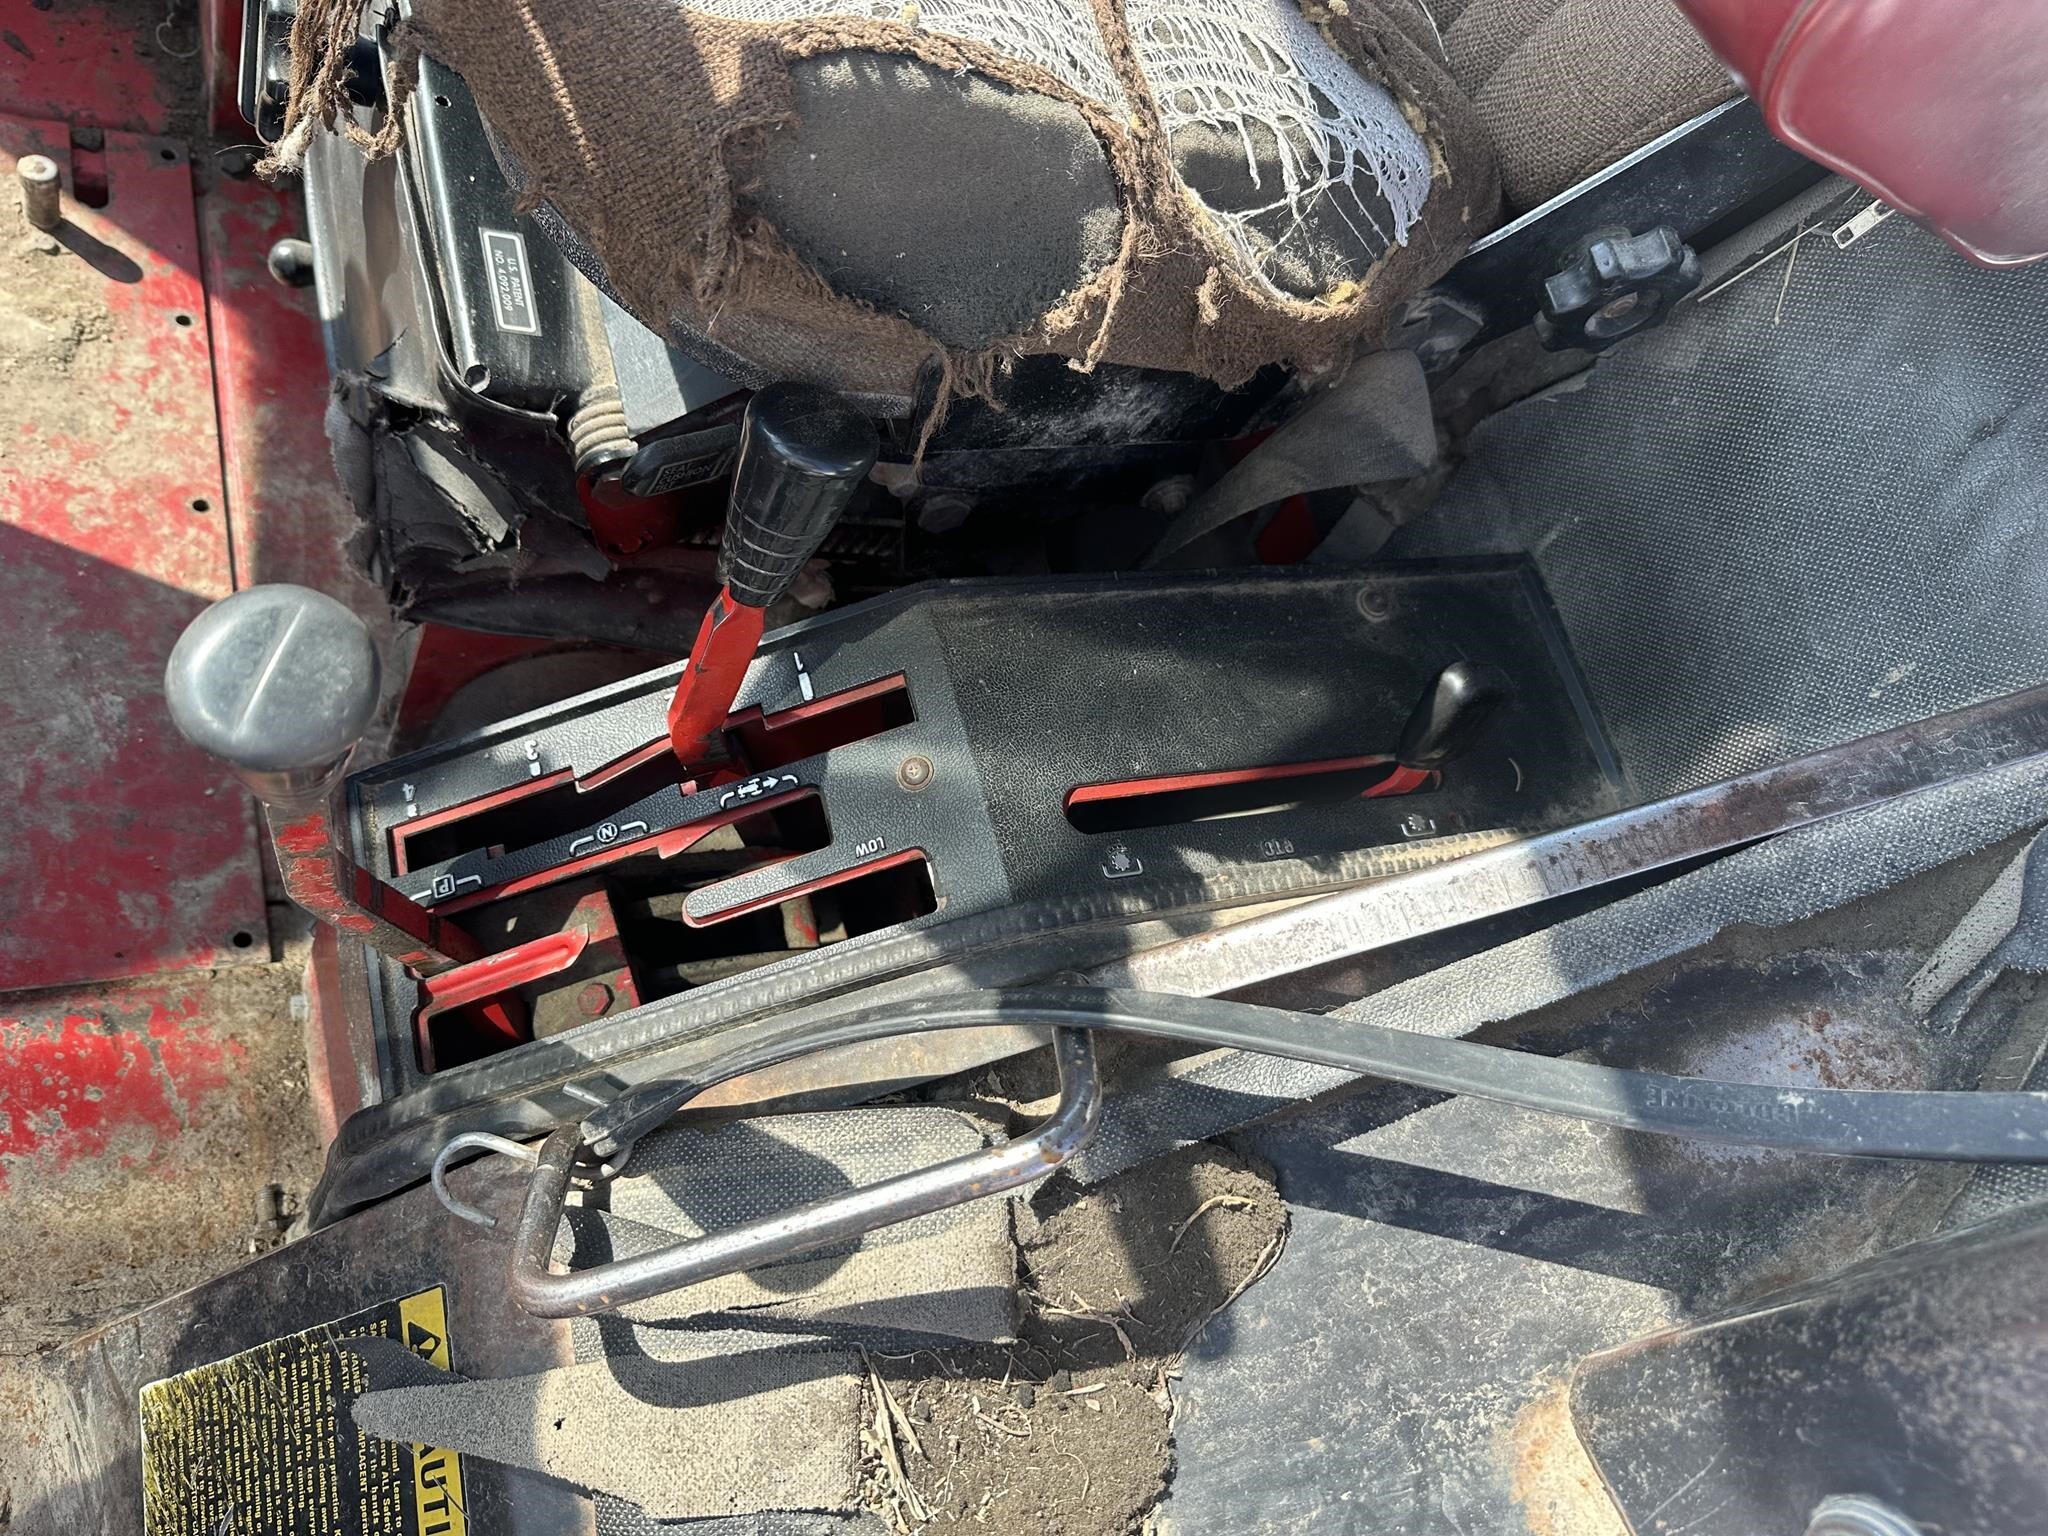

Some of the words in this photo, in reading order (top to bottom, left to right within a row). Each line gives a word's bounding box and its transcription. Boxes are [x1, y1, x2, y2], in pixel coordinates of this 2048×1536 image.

[494, 250, 505, 265] NO.
[507, 258, 518, 273] U.S.
[510, 277, 525, 307] PATENT
[793, 652, 804, 671] 1
[524, 740, 540, 760] 3
[403, 783, 416, 801] 4
[856, 836, 886, 857] LOW
[300, 1359, 307, 1376] NO
[310, 1355, 320, 1380] Keep
[322, 1352, 331, 1390] Shields
[339, 1350, 350, 1393] DEATH.
[351, 1352, 361, 1393] RAINED
[290, 1362, 300, 1404] anytime
[301, 1381, 311, 1427] RIDERS!
[232, 1425, 240, 1447] road
[315, 1418, 323, 1436] feet
[327, 1416, 335, 1431] for
[269, 1403, 278, 1438] certain
[275, 1494, 282, 1504] is
[283, 1444, 291, 1467] seat
[296, 1450, 303, 1461] is
[327, 1435, 335, 1459] your
[355, 1424, 368, 1492] MPLACENT
[379, 1439, 387, 1466] serve
[206, 1465, 212, 1476] to
[233, 1452, 242, 1480] travel
[252, 1449, 260, 1477] when
[369, 1458, 378, 1478] the
[198, 1480, 205, 1490] to
[243, 1468, 253, 1501] brakes
[285, 1471, 293, 1492] belt
[295, 1466, 306, 1511] running.
[305, 1466, 314, 1492] keep
[317, 1463, 327, 1503] clothing
[381, 1471, 389, 1492] ALL
[418, 1442, 450, 1536] UTI
[252, 1481, 262, 1518] turning
[328, 1464, 340, 1523] protection.
[370, 1486, 380, 1523] hands
[392, 1480, 402, 1511] Learn
[217, 1500, 225, 1519] and
[286, 1497, 295, 1526] when
[307, 1498, 317, 1536] everyo
[319, 1507, 328, 1533] away
[381, 1497, 391, 1533] Safety
[395, 1516, 402, 1527] to
[191, 1520, 199, 1536] CA
